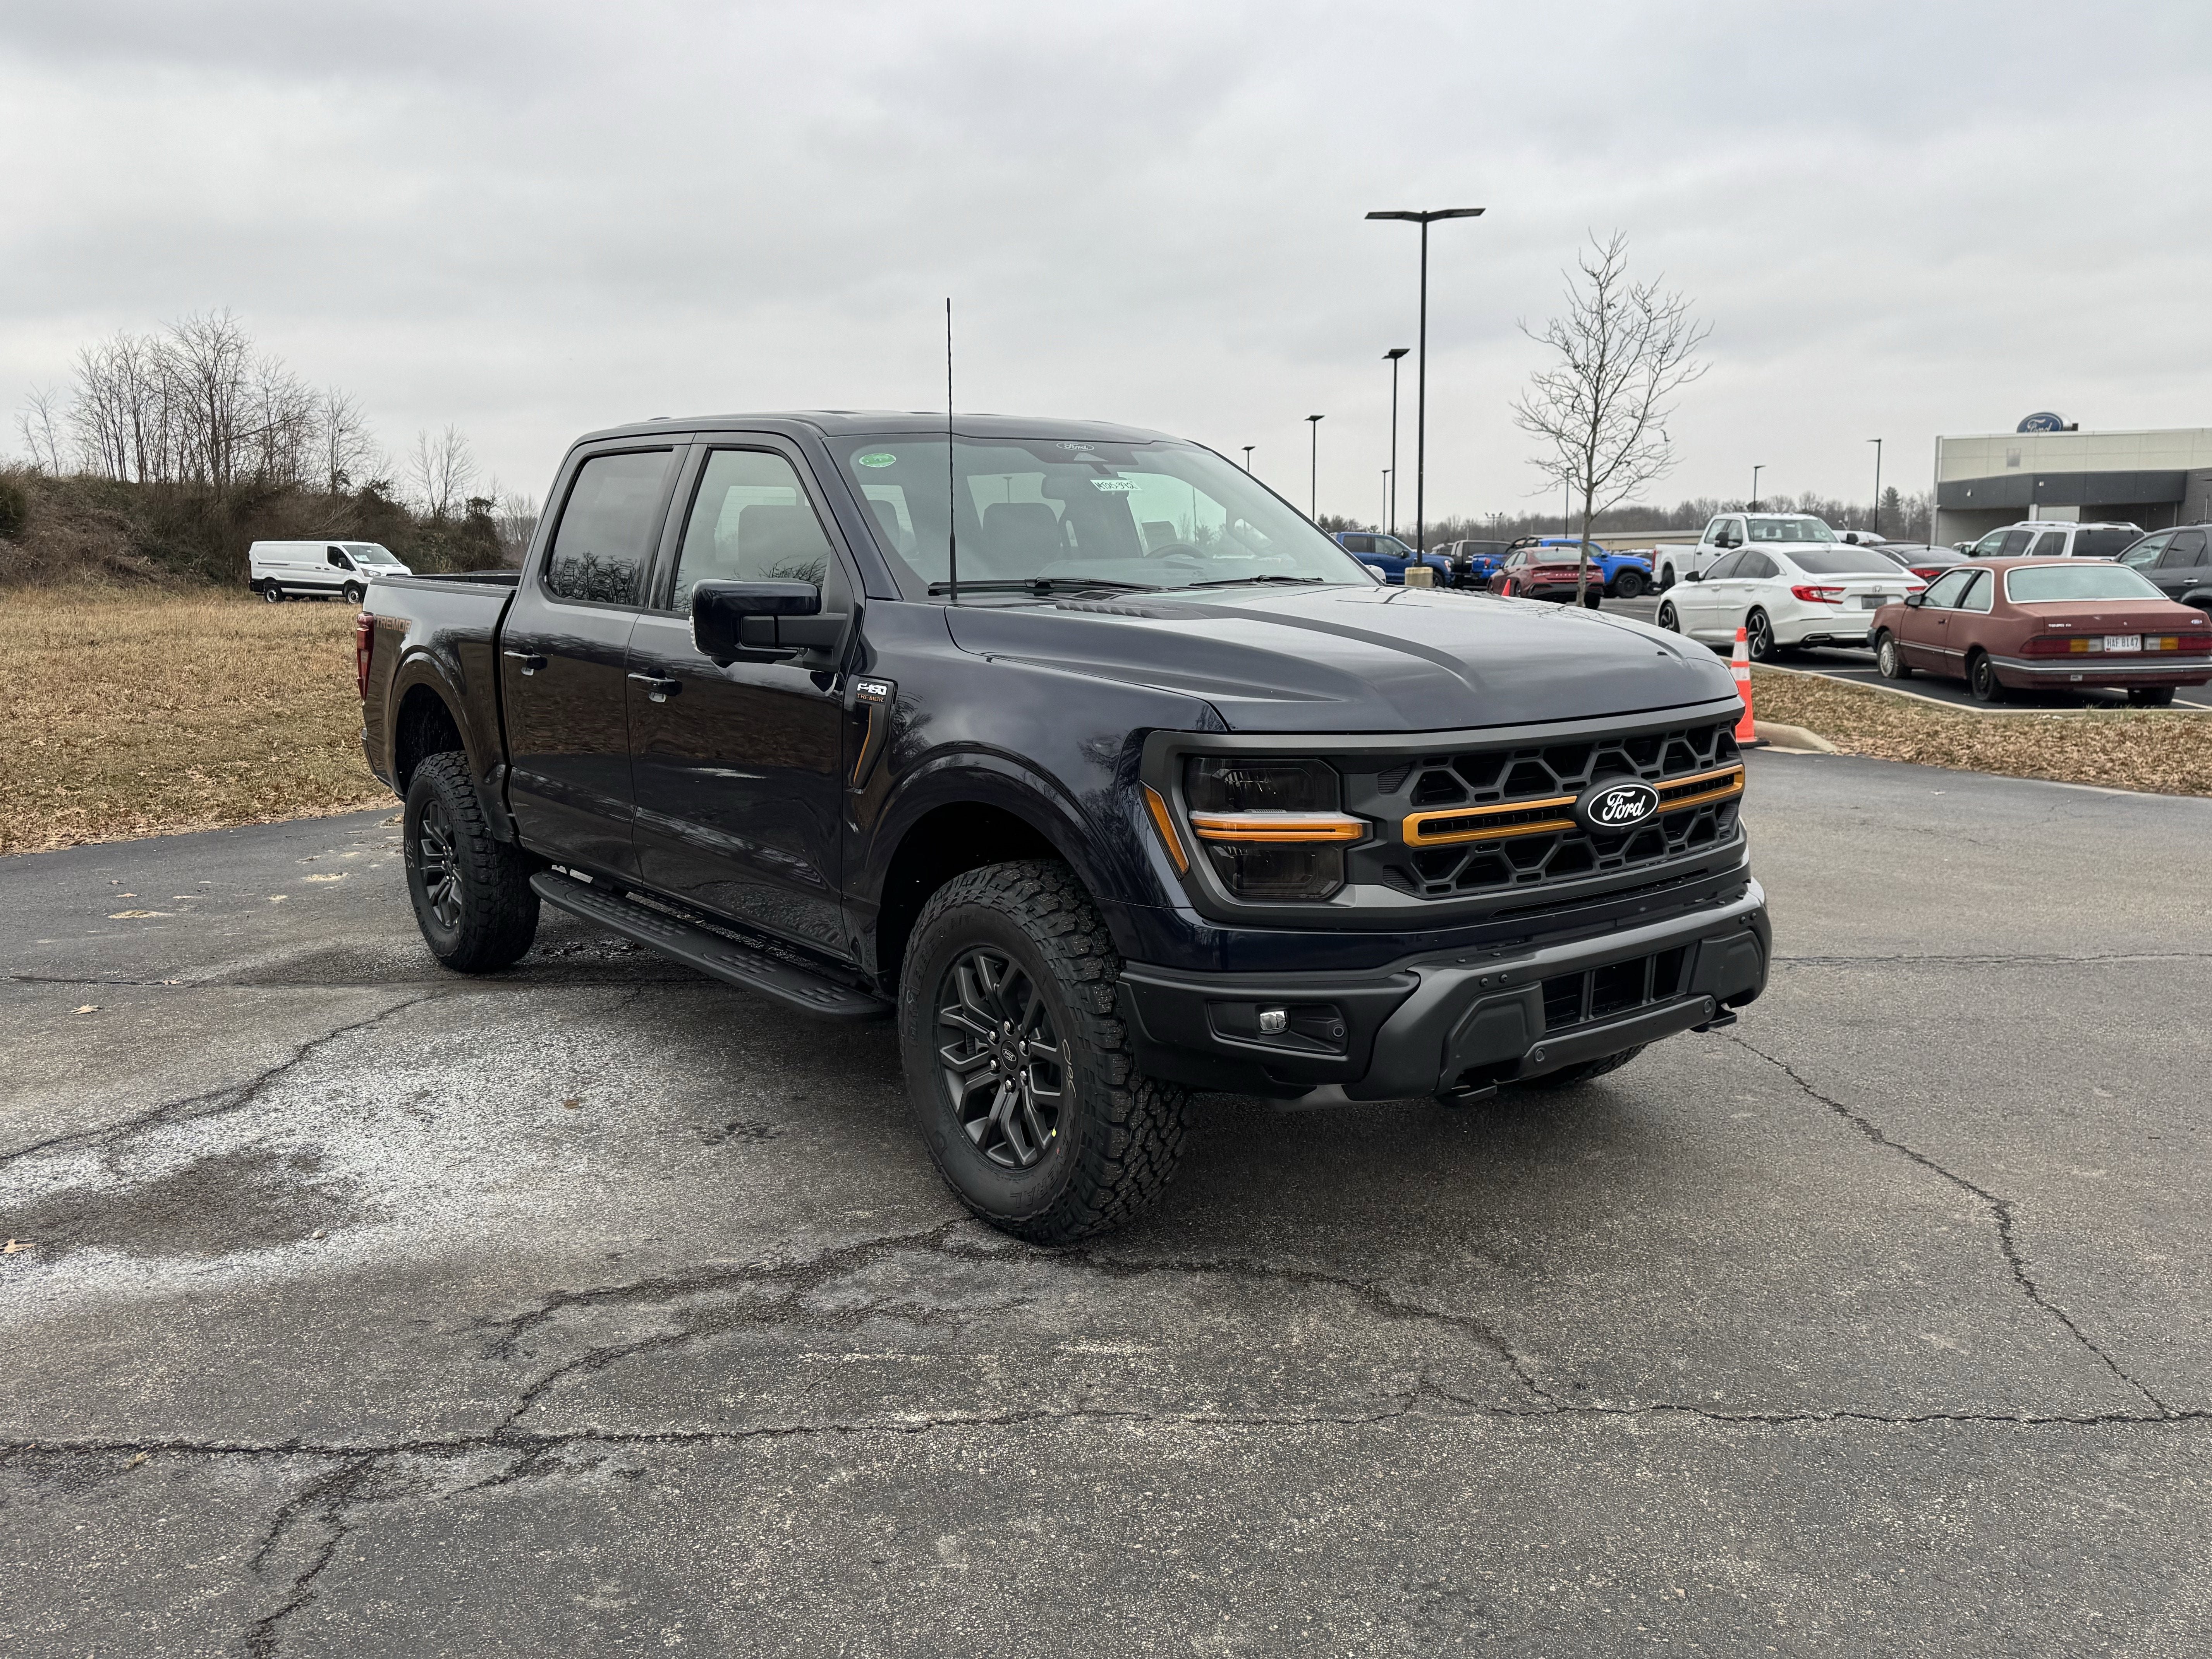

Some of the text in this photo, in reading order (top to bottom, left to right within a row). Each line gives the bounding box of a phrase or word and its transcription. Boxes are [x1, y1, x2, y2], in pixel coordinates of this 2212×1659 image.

[376, 615, 411, 634] TREMOR
[857, 694, 884, 702] TREMOR
[1602, 791, 1646, 821] Ford
